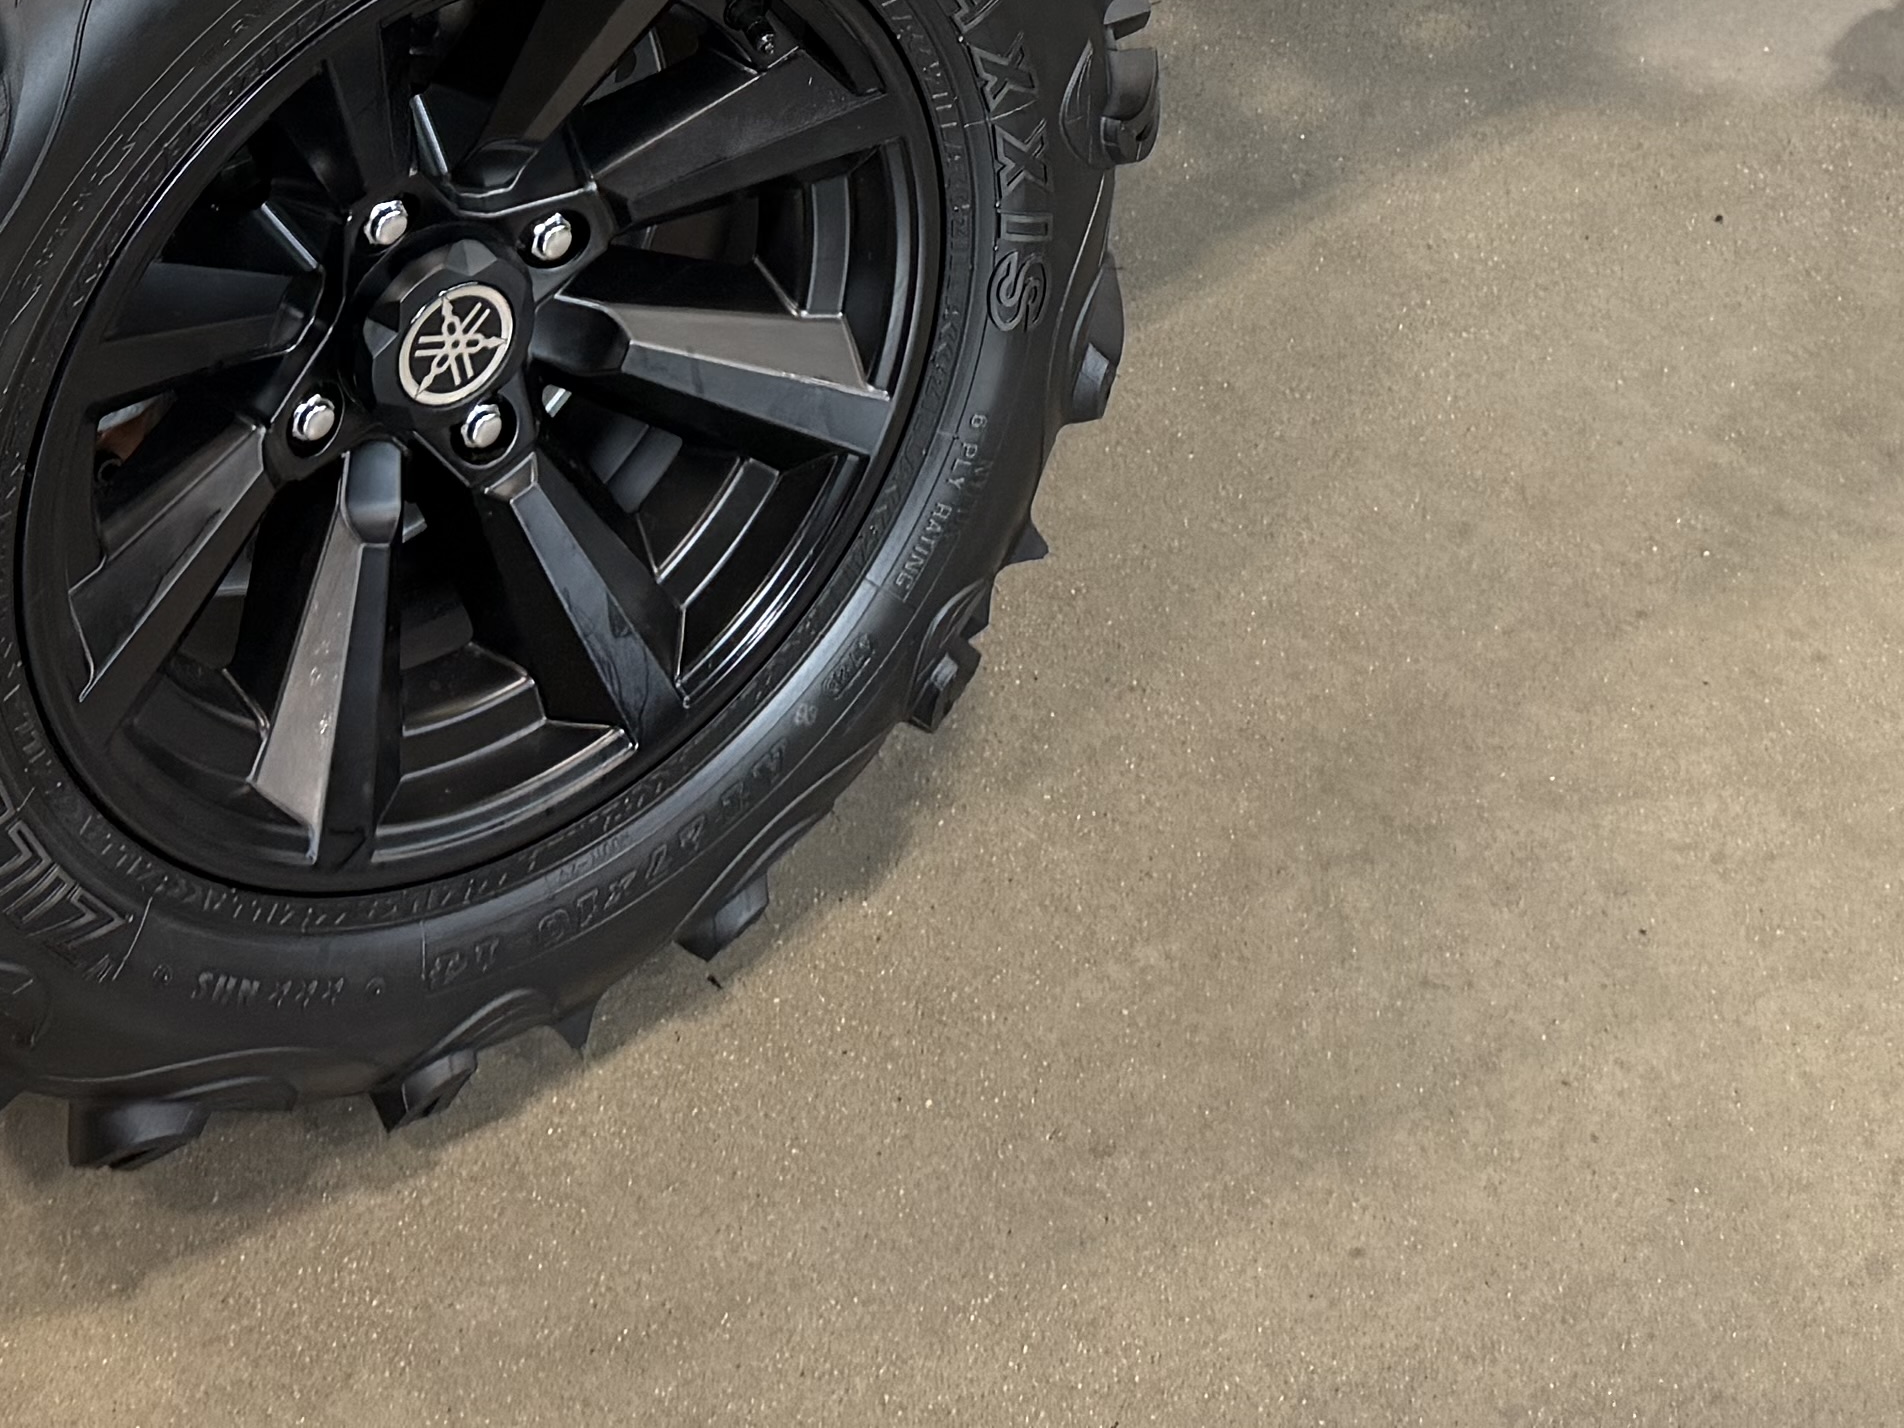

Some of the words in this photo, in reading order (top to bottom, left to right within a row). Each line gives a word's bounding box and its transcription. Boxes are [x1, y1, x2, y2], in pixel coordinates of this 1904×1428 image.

[970, 413, 988, 430] 6
[947, 442, 979, 490] PLY
[895, 502, 953, 590] RATING
